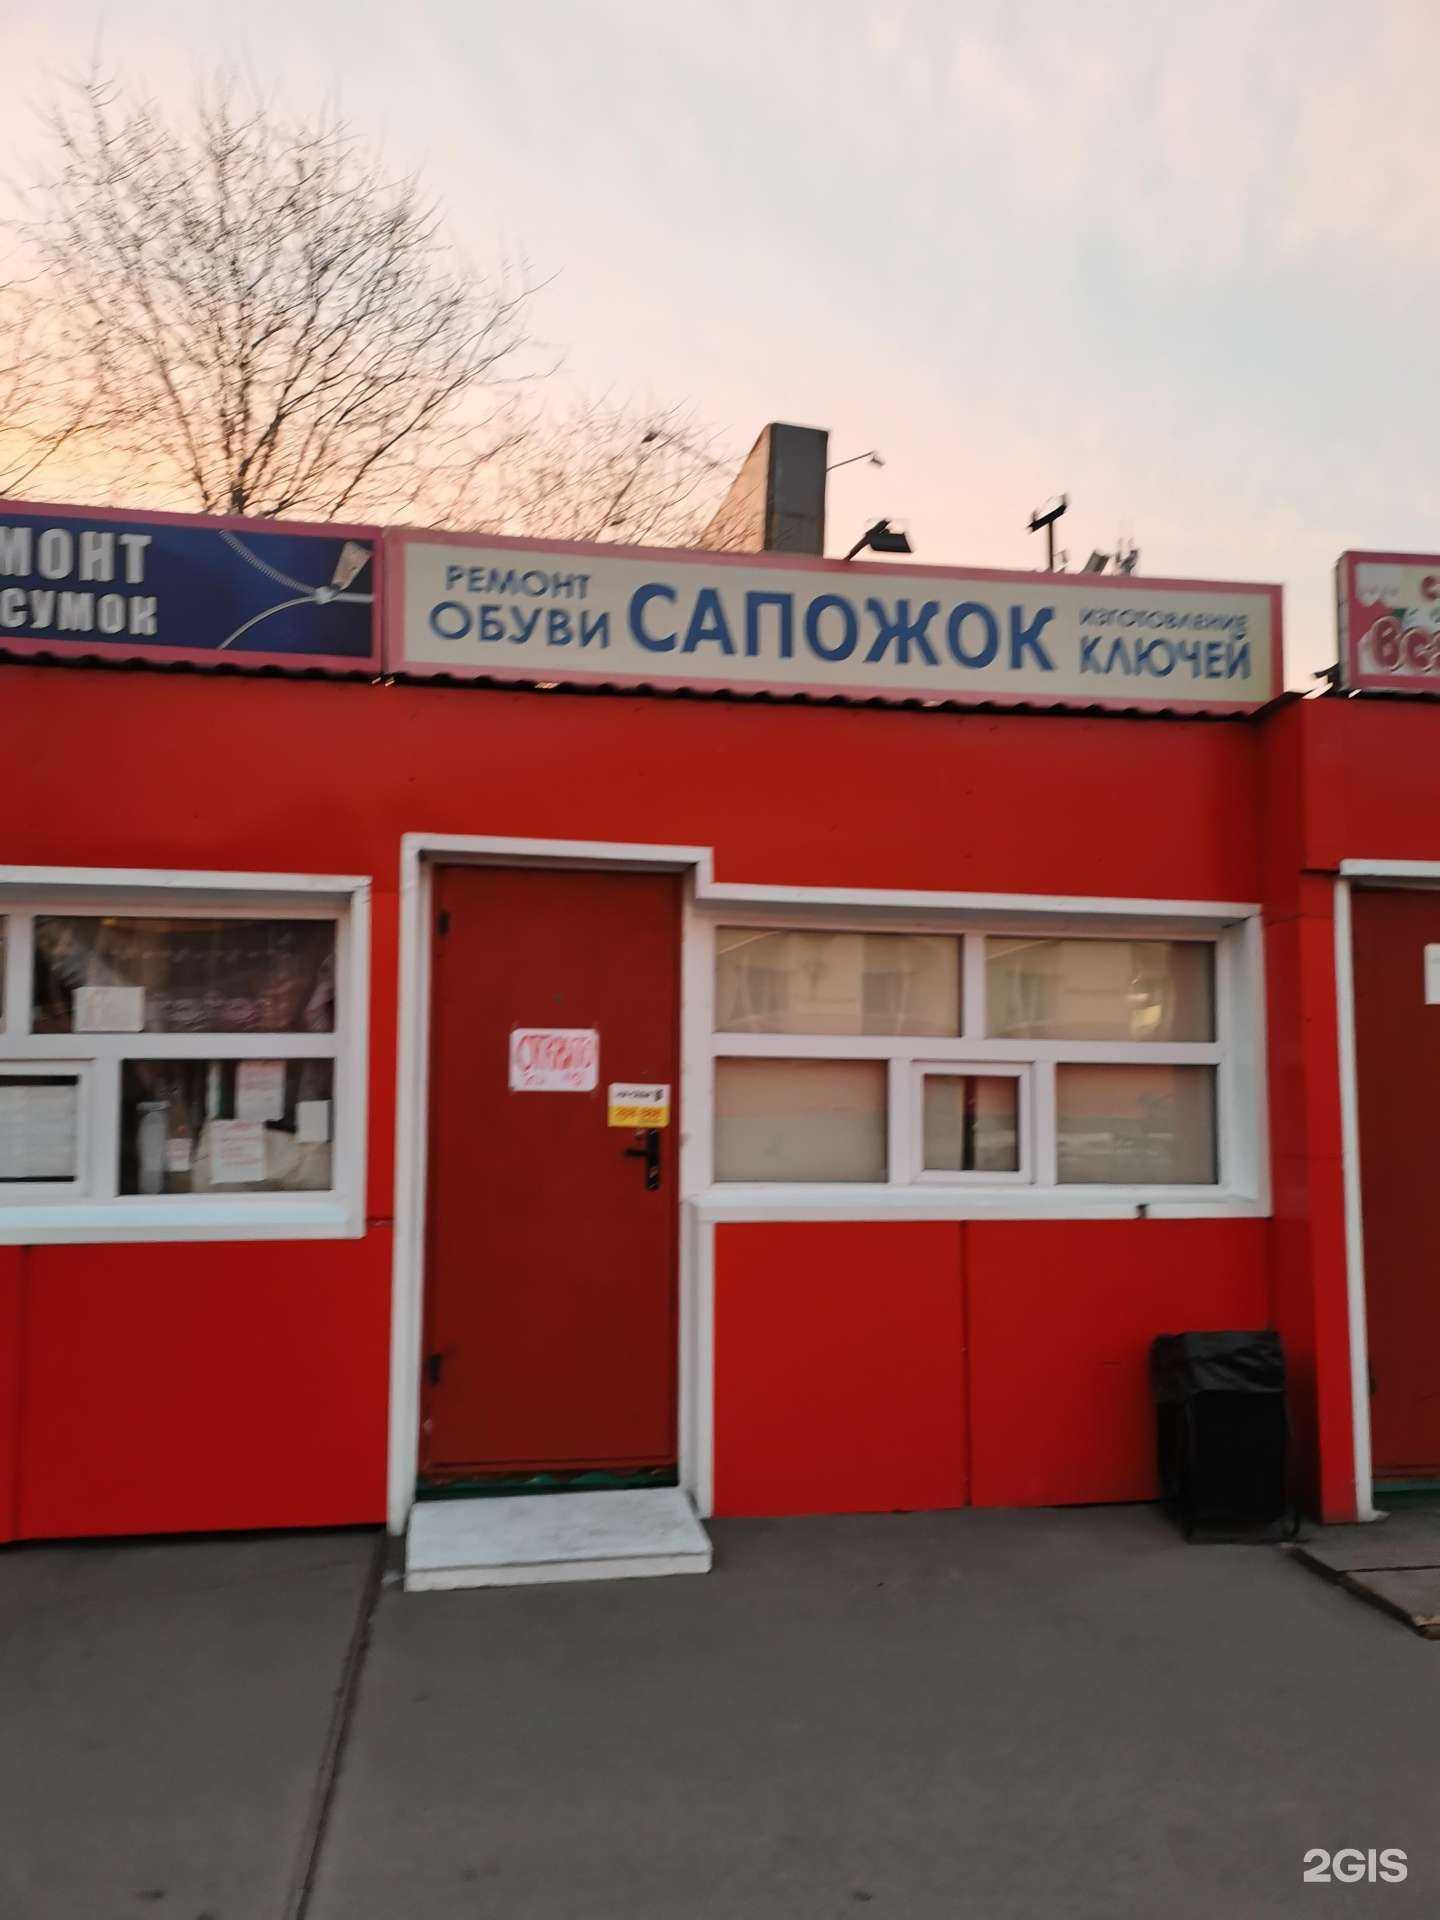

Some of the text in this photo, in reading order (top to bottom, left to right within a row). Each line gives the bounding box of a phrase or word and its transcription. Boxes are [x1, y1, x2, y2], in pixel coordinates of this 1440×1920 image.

[0, 526, 152, 583] МОНТ
[446, 565, 591, 599] РЕМОНТ
[0, 587, 157, 635] СУМОК
[429, 601, 610, 649] ОБУВИ
[629, 583, 1057, 671] САПОЖОК
[1079, 608, 1248, 633] ИЗГОТОВЛЕНИЕ
[1079, 633, 1251, 680] КЛЮЧЕЙ
